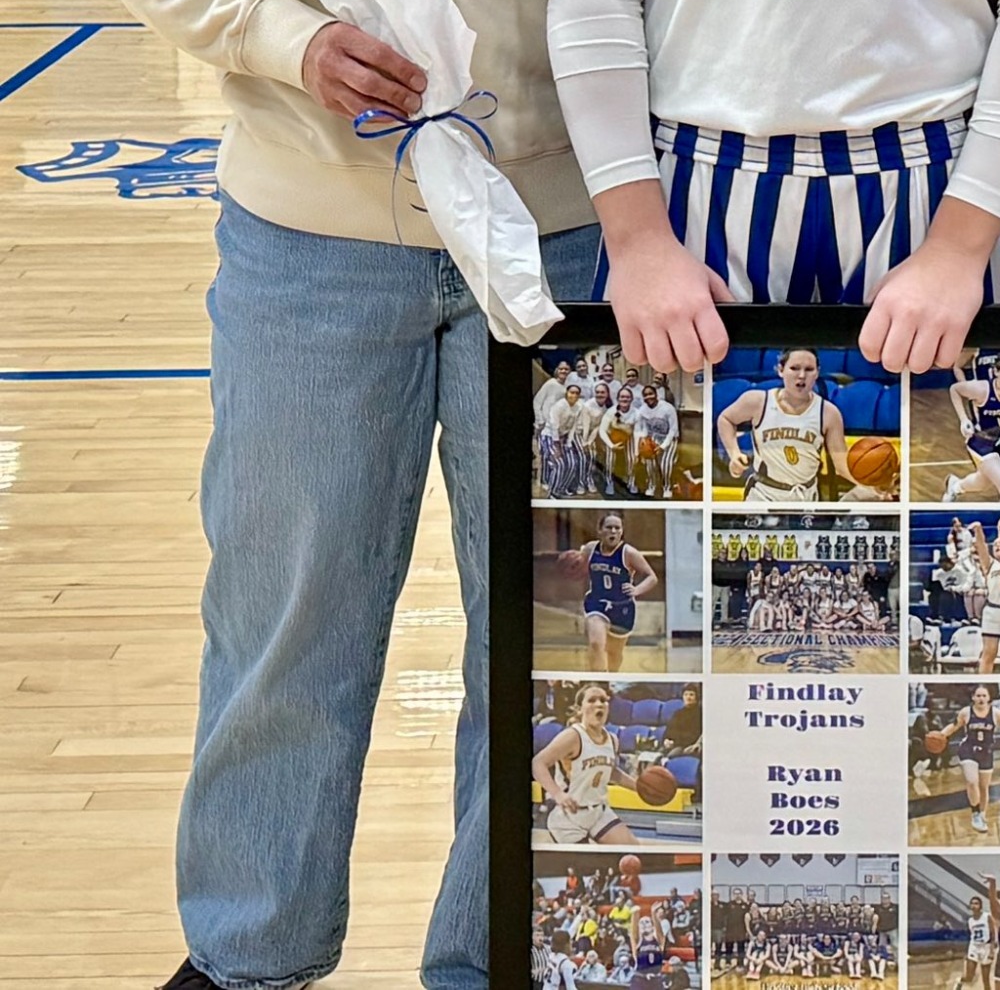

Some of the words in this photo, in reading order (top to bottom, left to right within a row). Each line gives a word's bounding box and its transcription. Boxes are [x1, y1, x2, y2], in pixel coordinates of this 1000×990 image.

[783, 445, 799, 465] 0
[603, 574, 612, 590] 0
[748, 682, 863, 705] Findlay
[744, 709, 865, 732] Trojans
[767, 765, 843, 786] Ryan
[770, 792, 840, 809] Boes
[769, 819, 840, 836] 2026
